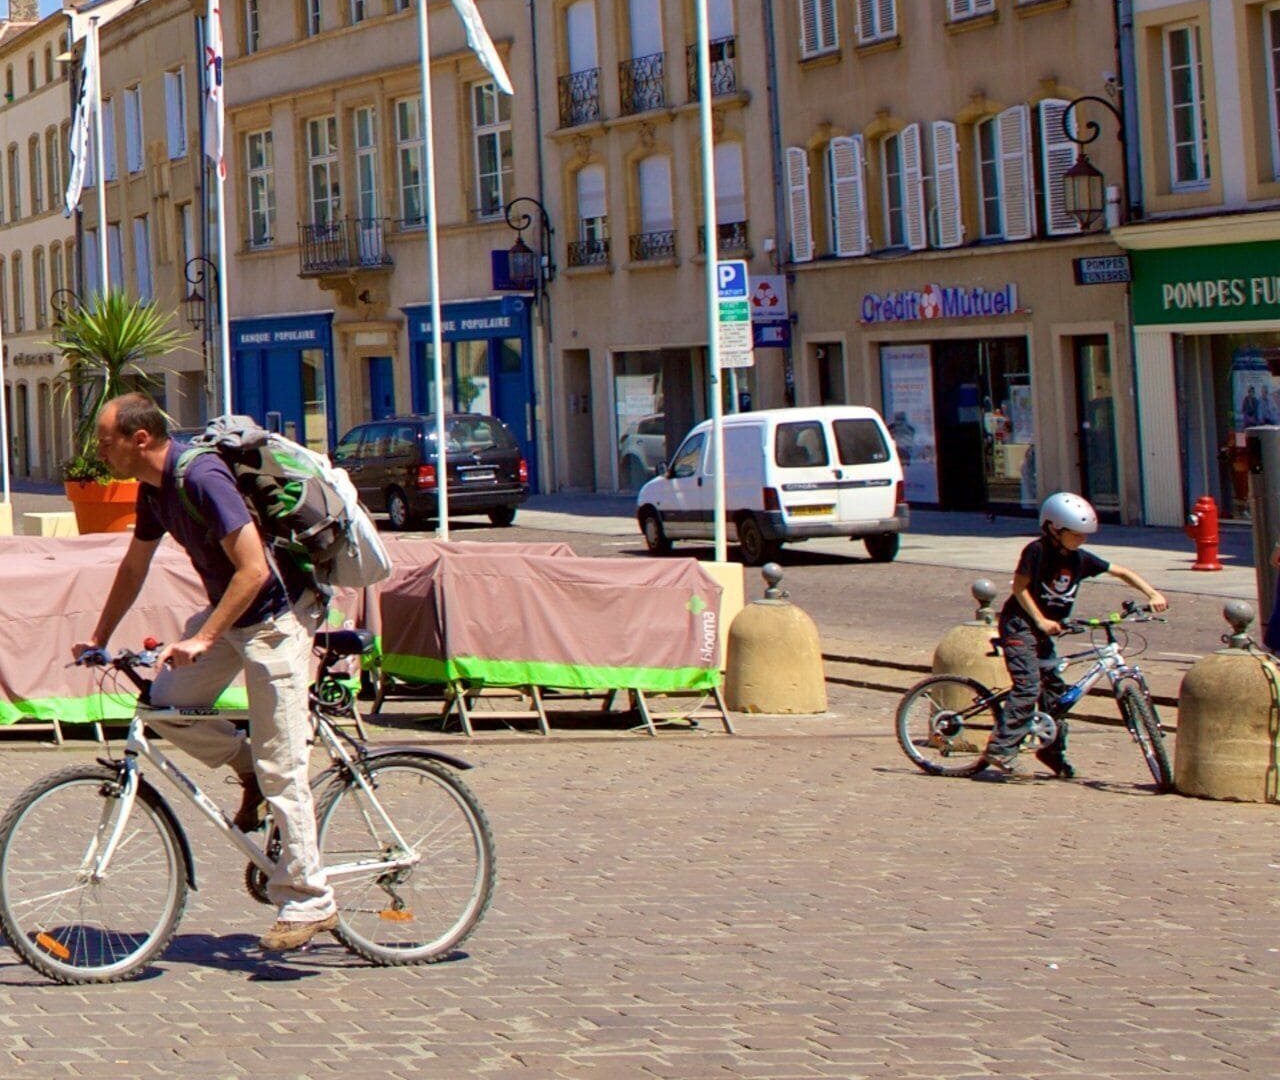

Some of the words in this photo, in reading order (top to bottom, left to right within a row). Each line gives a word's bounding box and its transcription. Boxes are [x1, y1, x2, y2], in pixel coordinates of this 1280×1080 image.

[719, 265, 736, 289] P
[861, 291, 920, 323] Crédit
[941, 283, 1016, 317] Mutuel
[1162, 278, 1246, 310] POMPES
[1250, 276, 1280, 306] FU
[241, 331, 271, 344] BANQUE
[274, 329, 316, 341] POPULAIRE
[461, 316, 511, 330] POPULAIRE
[700, 611, 715, 662] blooma
